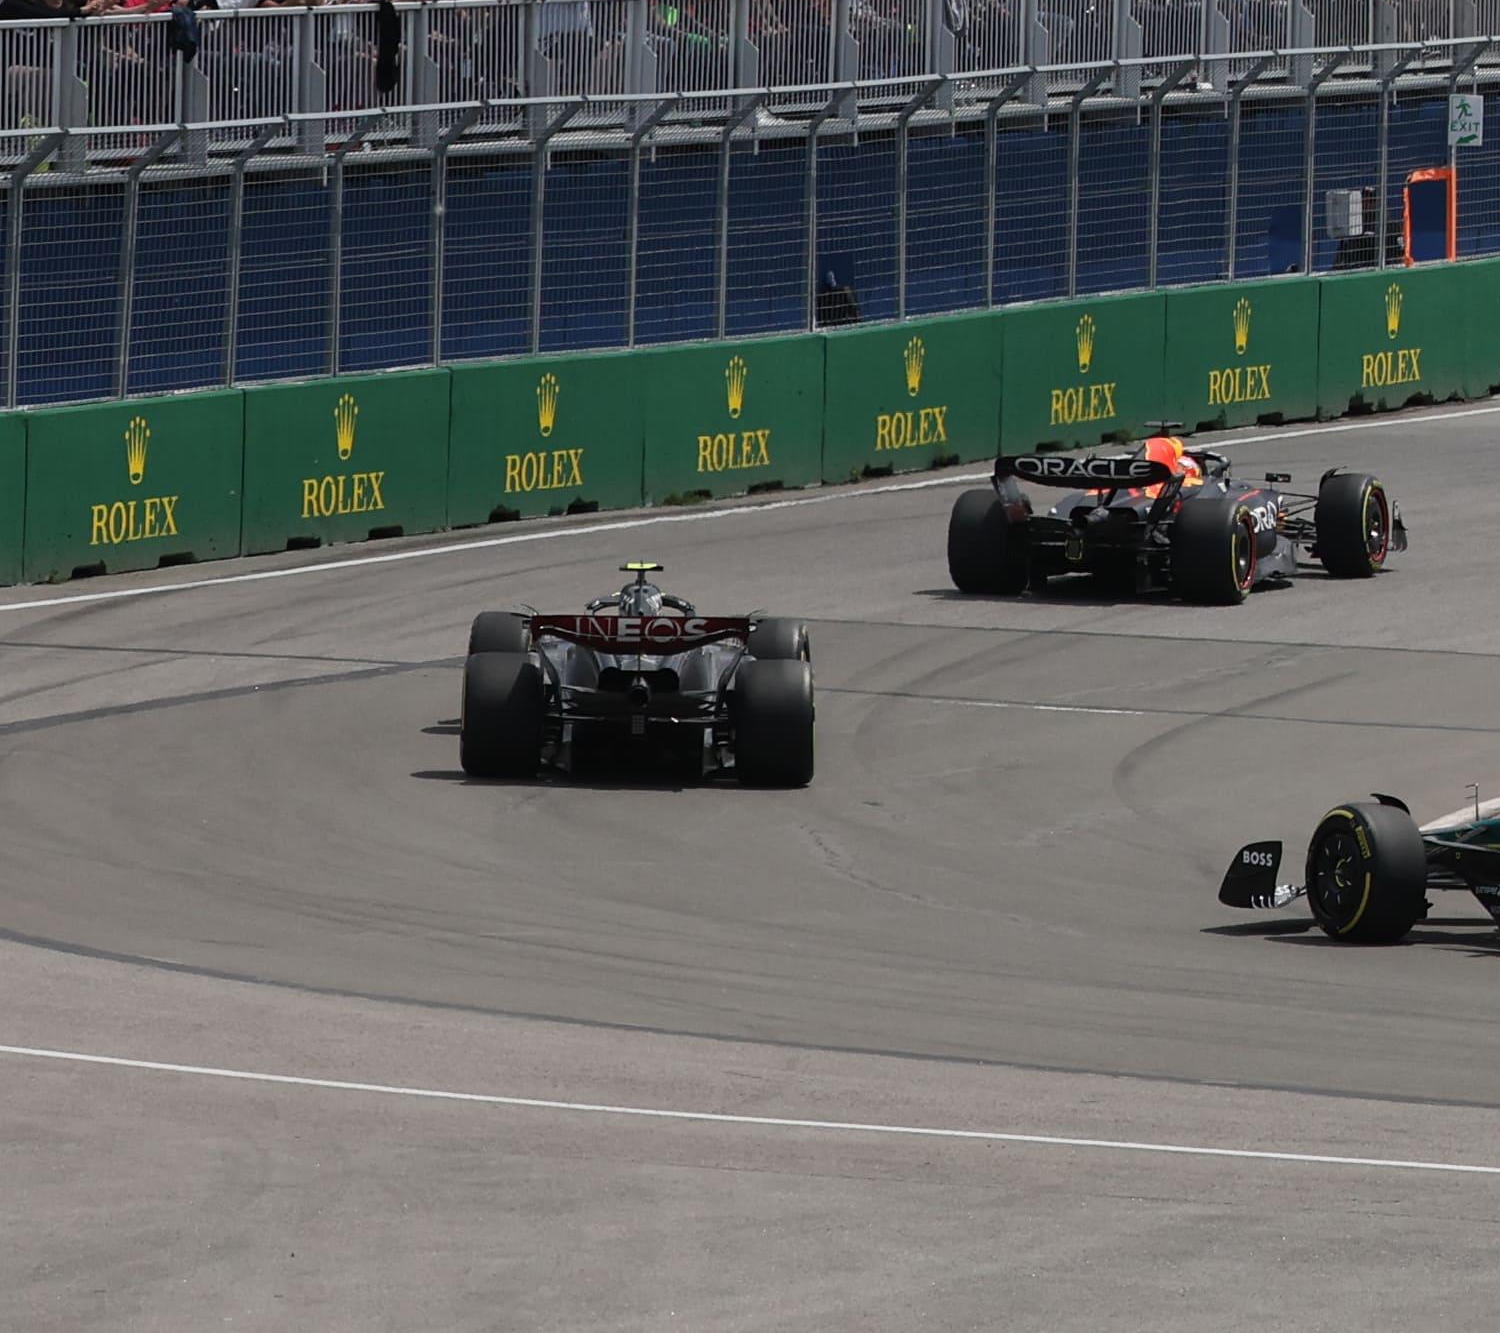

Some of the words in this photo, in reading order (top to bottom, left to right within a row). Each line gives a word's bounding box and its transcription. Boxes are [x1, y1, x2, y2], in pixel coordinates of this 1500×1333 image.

[1450, 120, 1480, 132] EXIT
[1209, 365, 1270, 404] ROLEX
[1363, 349, 1421, 386] ROLEX
[1051, 383, 1115, 424] ROLEX
[876, 407, 947, 451] ROLEX
[505, 448, 583, 492] ROLEX
[698, 429, 770, 472] ROLEX
[1015, 457, 1152, 479] ORACLE
[302, 472, 384, 518] ROLEX
[91, 497, 178, 545] ROLEX
[576, 617, 708, 643] INEOS
[1242, 850, 1273, 867] BOSS
